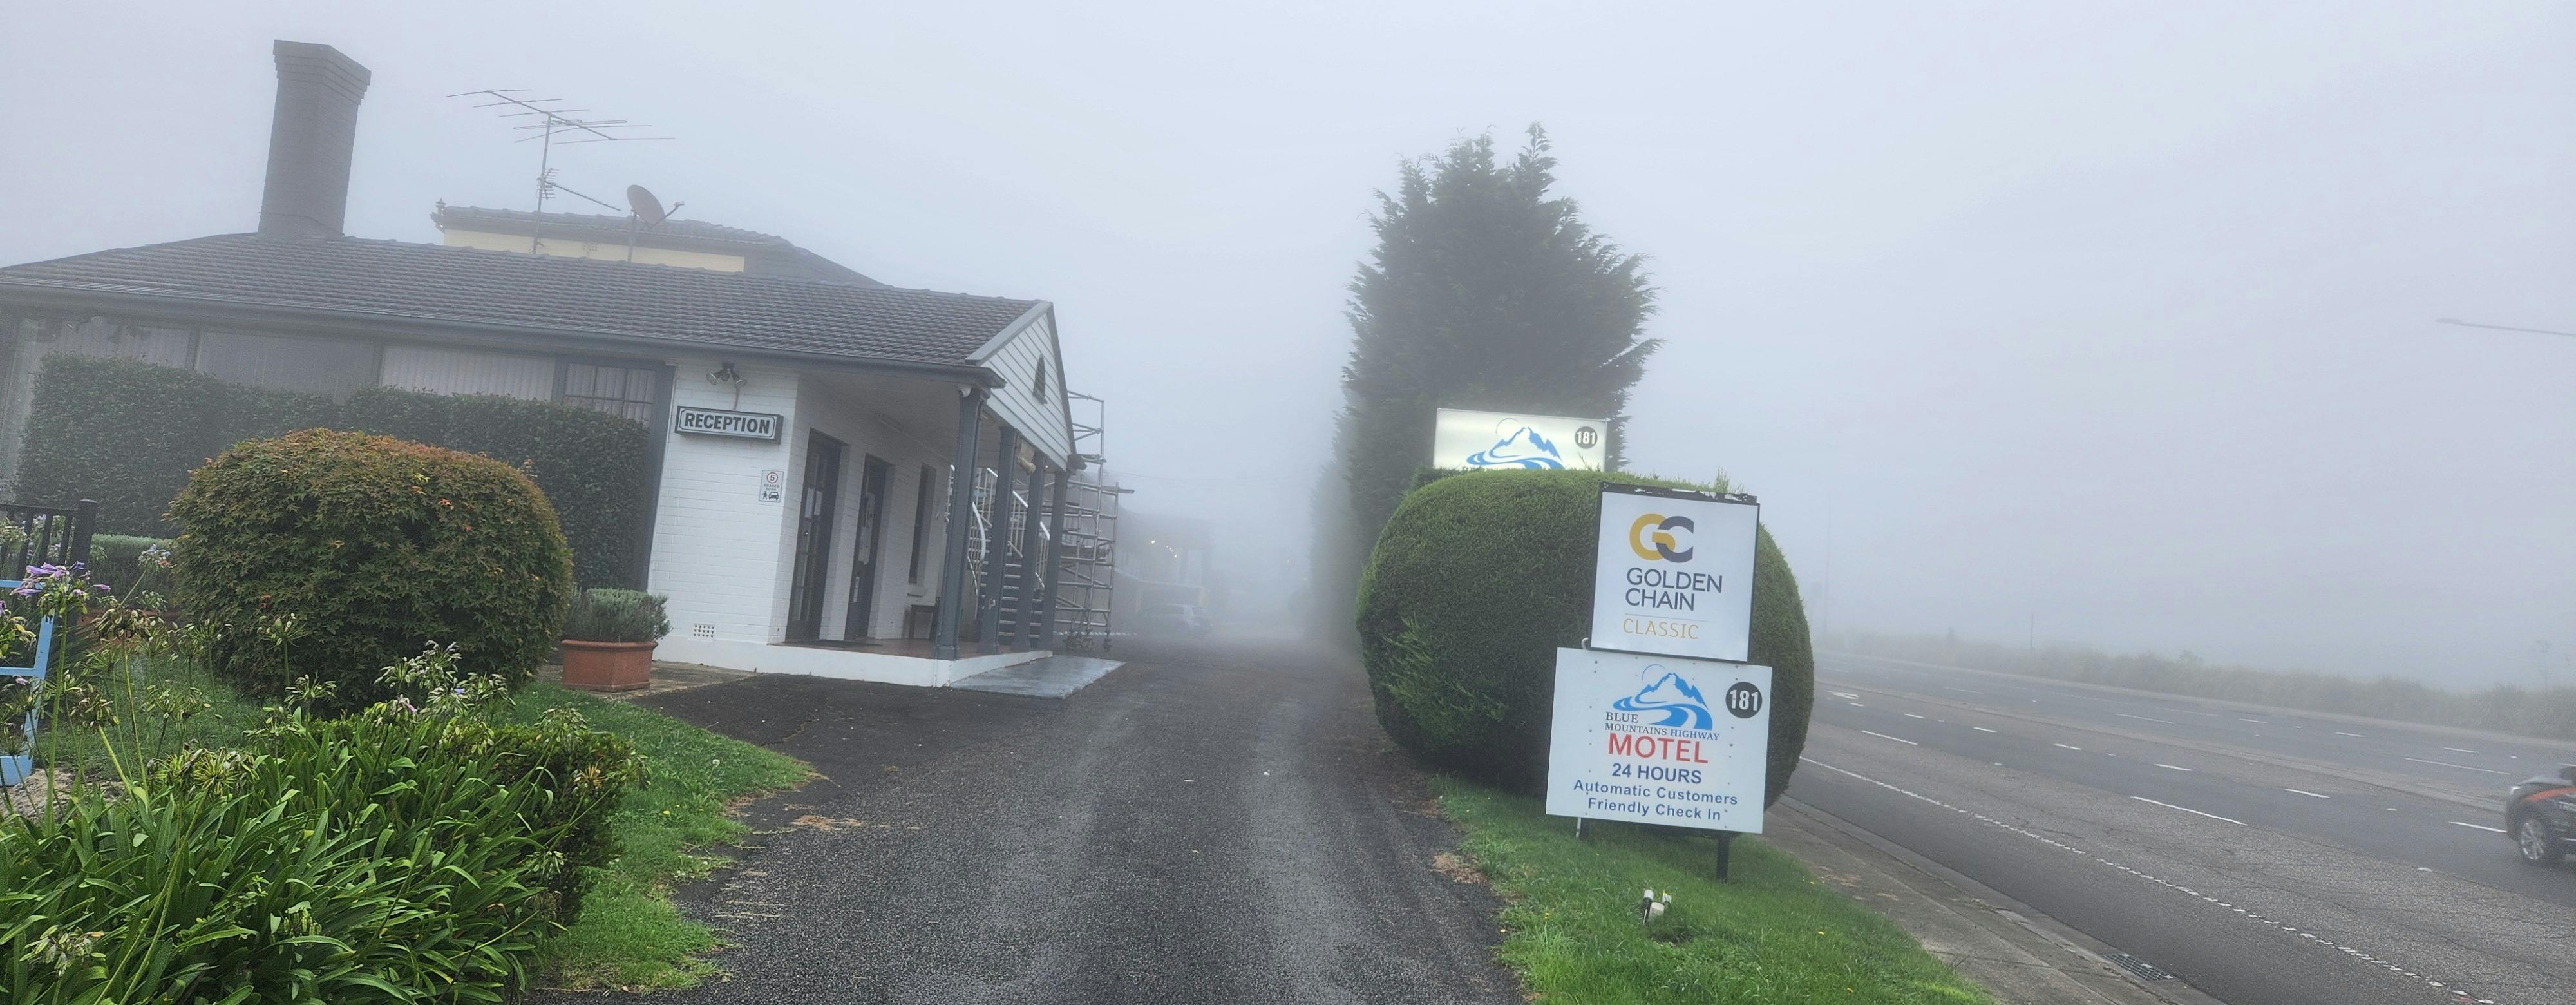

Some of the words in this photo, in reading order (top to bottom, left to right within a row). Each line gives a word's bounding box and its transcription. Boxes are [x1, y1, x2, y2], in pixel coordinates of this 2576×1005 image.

[684, 412, 770, 434] RECEPTION
[1577, 431, 1596, 445] 181
[1629, 513, 1694, 563] GC
[1627, 567, 1723, 593] GOLDEN
[1625, 588, 1695, 611] CHAIN
[1623, 618, 1699, 639] CLASSIC
[1730, 689, 1759, 711] 181
[1605, 711, 1638, 723] BLUE
[1605, 723, 1667, 736] MOUNTAINS
[1670, 729, 1720, 741] HIGHWAY
[1608, 732, 1709, 764] MOTEL
[1612, 763, 1631, 778] 24
[1638, 765, 1702, 784] HOURS
[1573, 780, 1651, 798] Automatic
[1656, 787, 1738, 805] Customers
[1588, 797, 1650, 816] Friendly
[1655, 803, 1701, 819] Check
[1707, 809, 1721, 820] In
